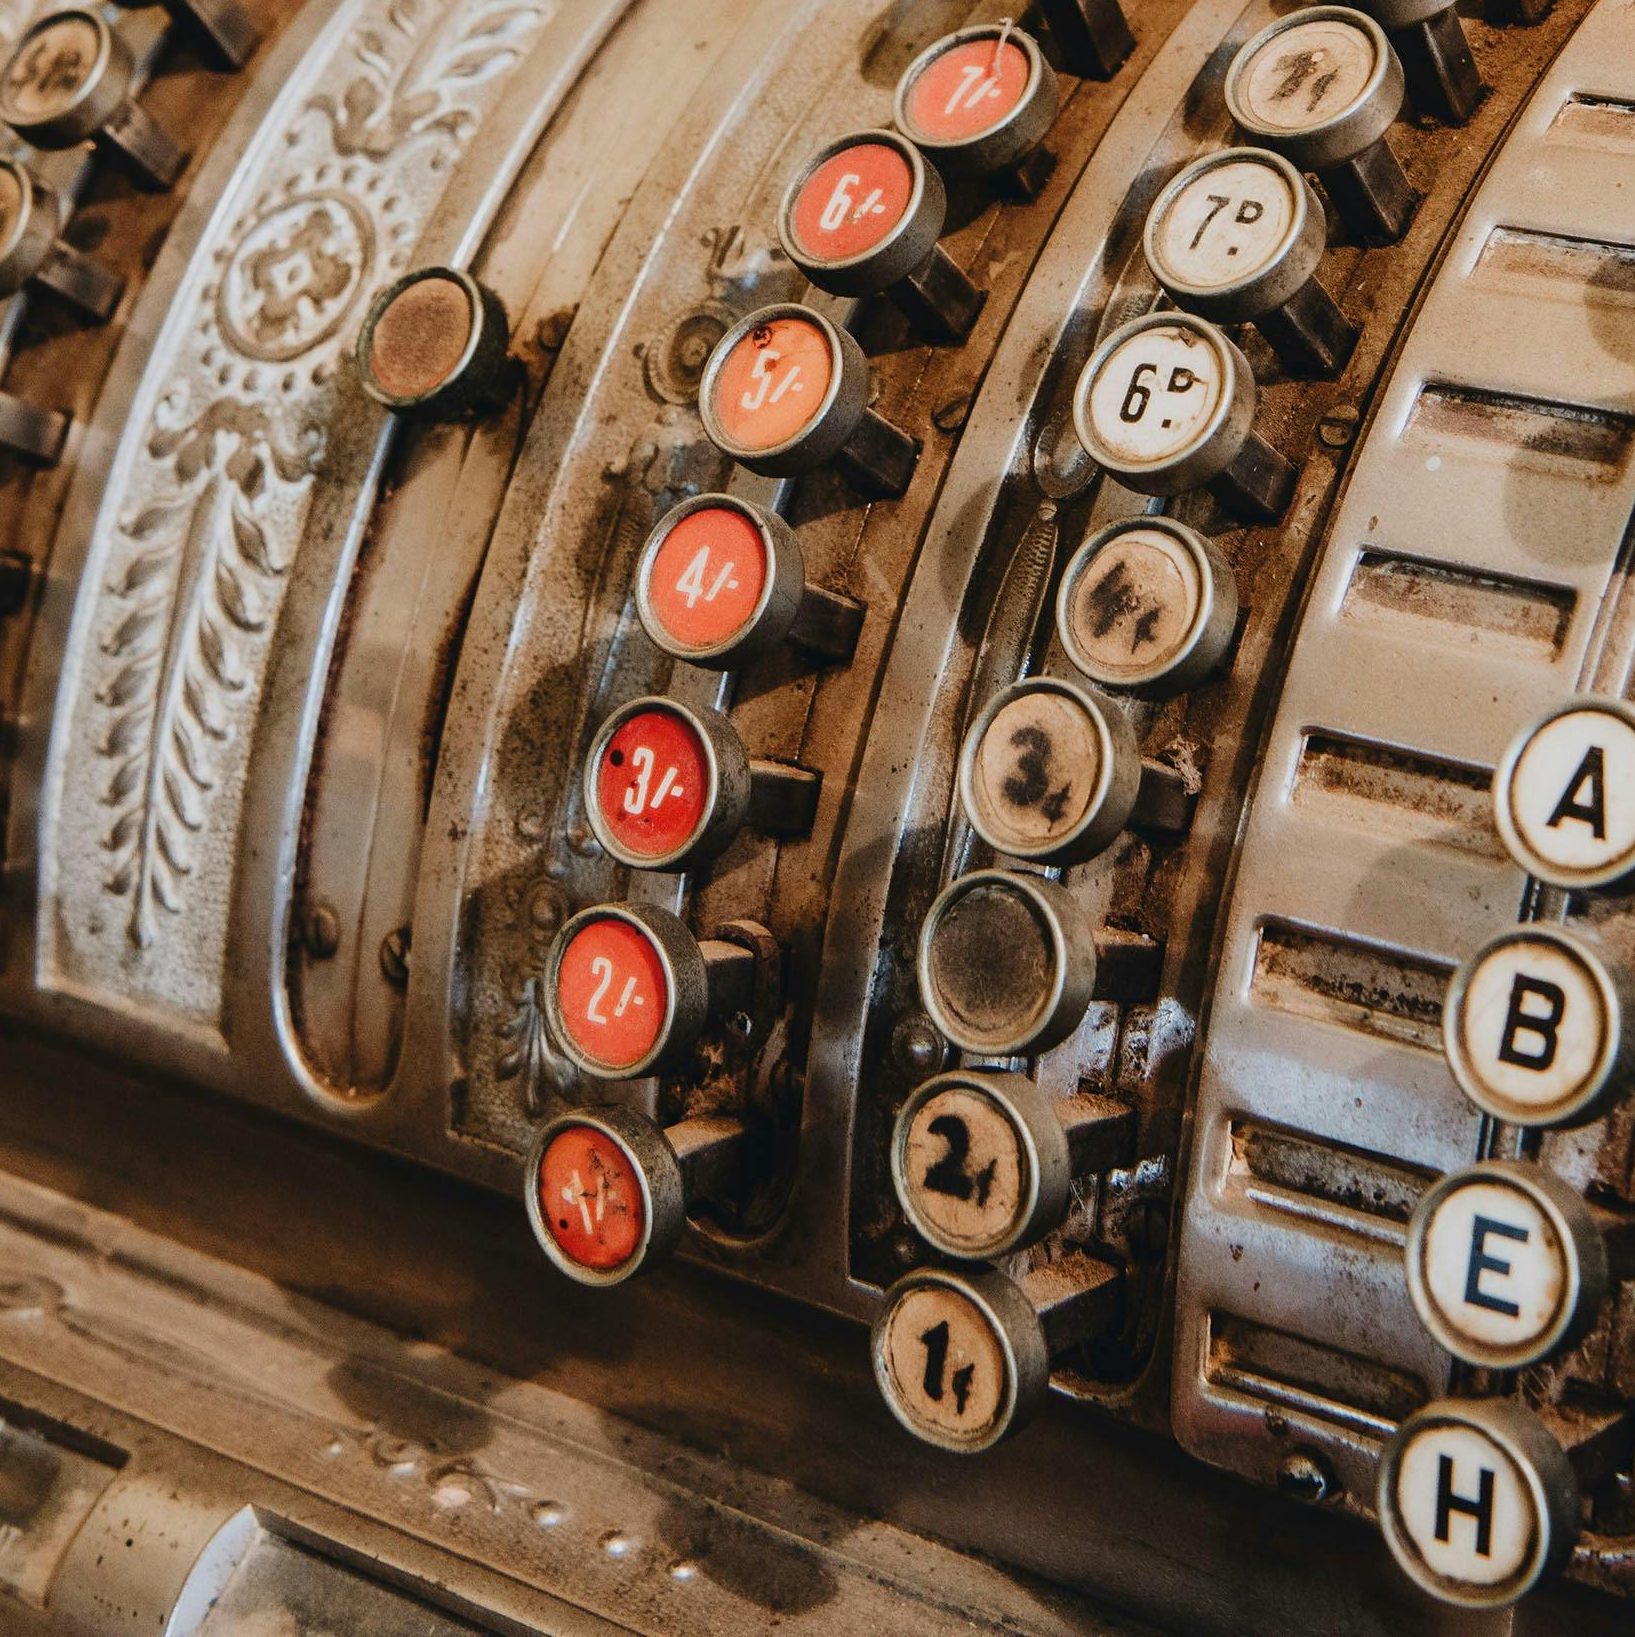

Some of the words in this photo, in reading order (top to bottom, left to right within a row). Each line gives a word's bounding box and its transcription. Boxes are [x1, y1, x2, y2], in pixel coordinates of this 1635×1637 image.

[674, 545, 739, 610] 4/-
[622, 745, 685, 817] 3/-
[1545, 744, 1609, 844] A
[586, 955, 645, 1027] 2/-
[1495, 970, 1567, 1073] B
[1463, 1213, 1530, 1318] E
[1433, 1452, 1496, 1559] H
